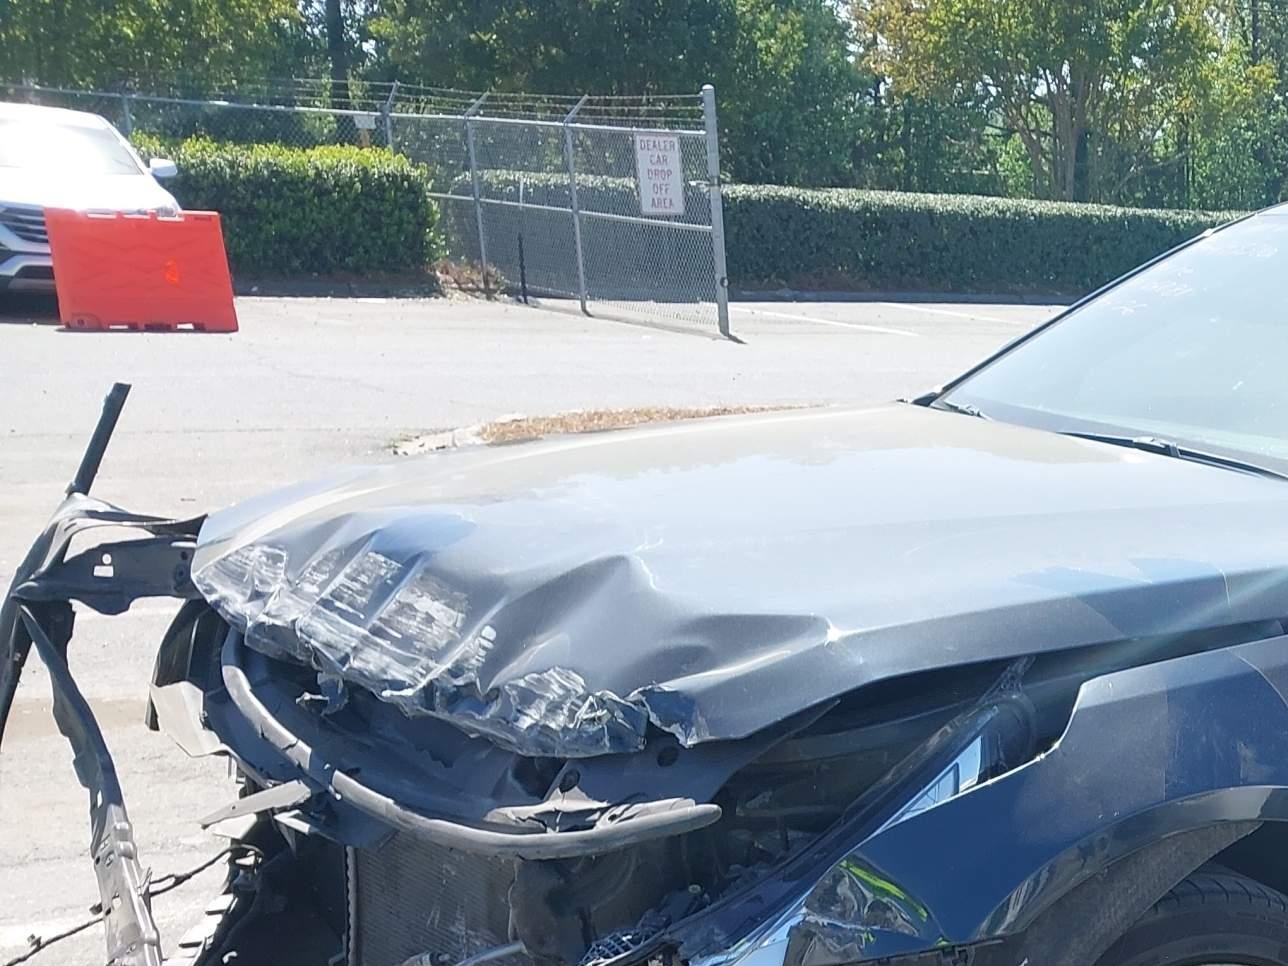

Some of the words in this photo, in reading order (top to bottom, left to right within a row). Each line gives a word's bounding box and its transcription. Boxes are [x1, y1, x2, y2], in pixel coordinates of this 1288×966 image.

[640, 139, 676, 151] DEALER
[649, 155, 668, 166] CAR
[647, 168, 673, 180] DROP
[652, 183, 671, 195] OFF
[651, 197, 674, 209] AREA
